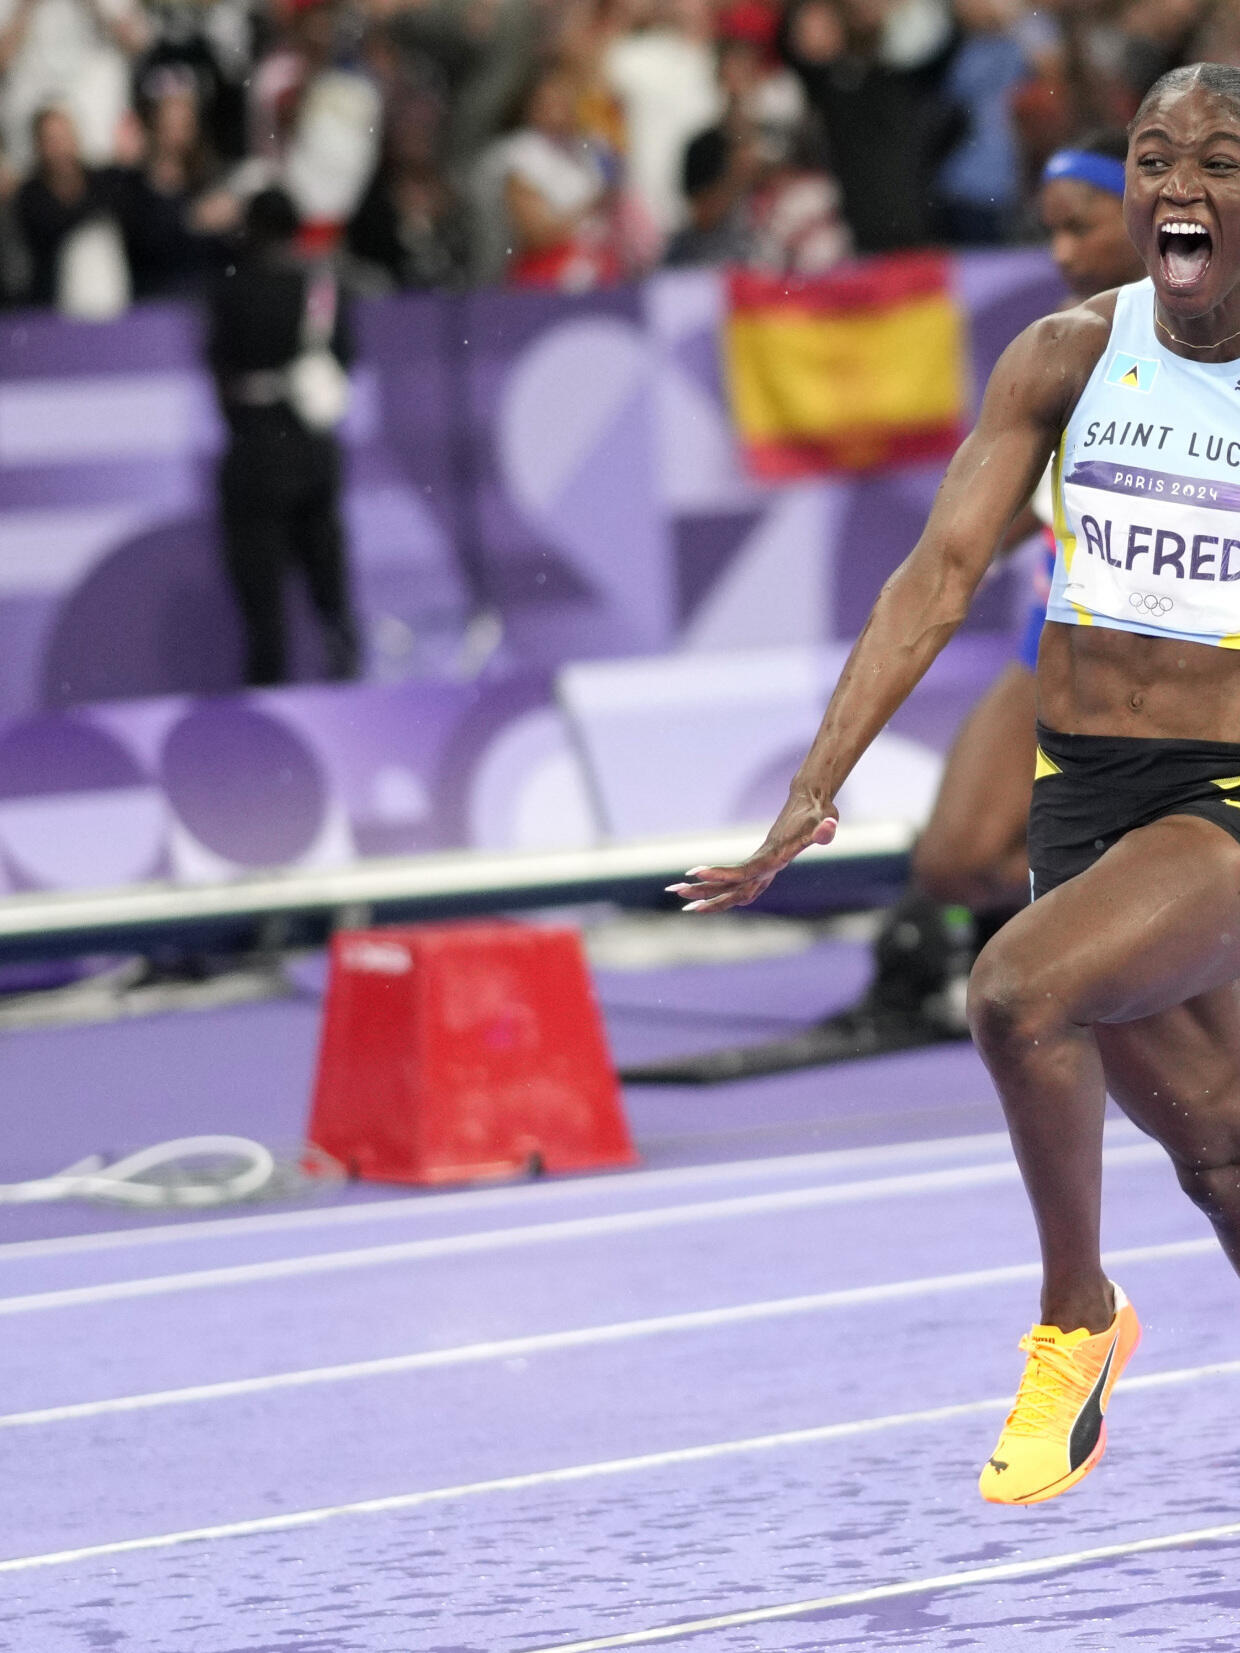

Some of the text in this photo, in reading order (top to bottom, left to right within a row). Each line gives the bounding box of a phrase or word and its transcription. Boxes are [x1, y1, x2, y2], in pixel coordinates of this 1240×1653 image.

[1083, 421, 1174, 450] SAINT
[1113, 471, 1218, 501] PARIS 2024
